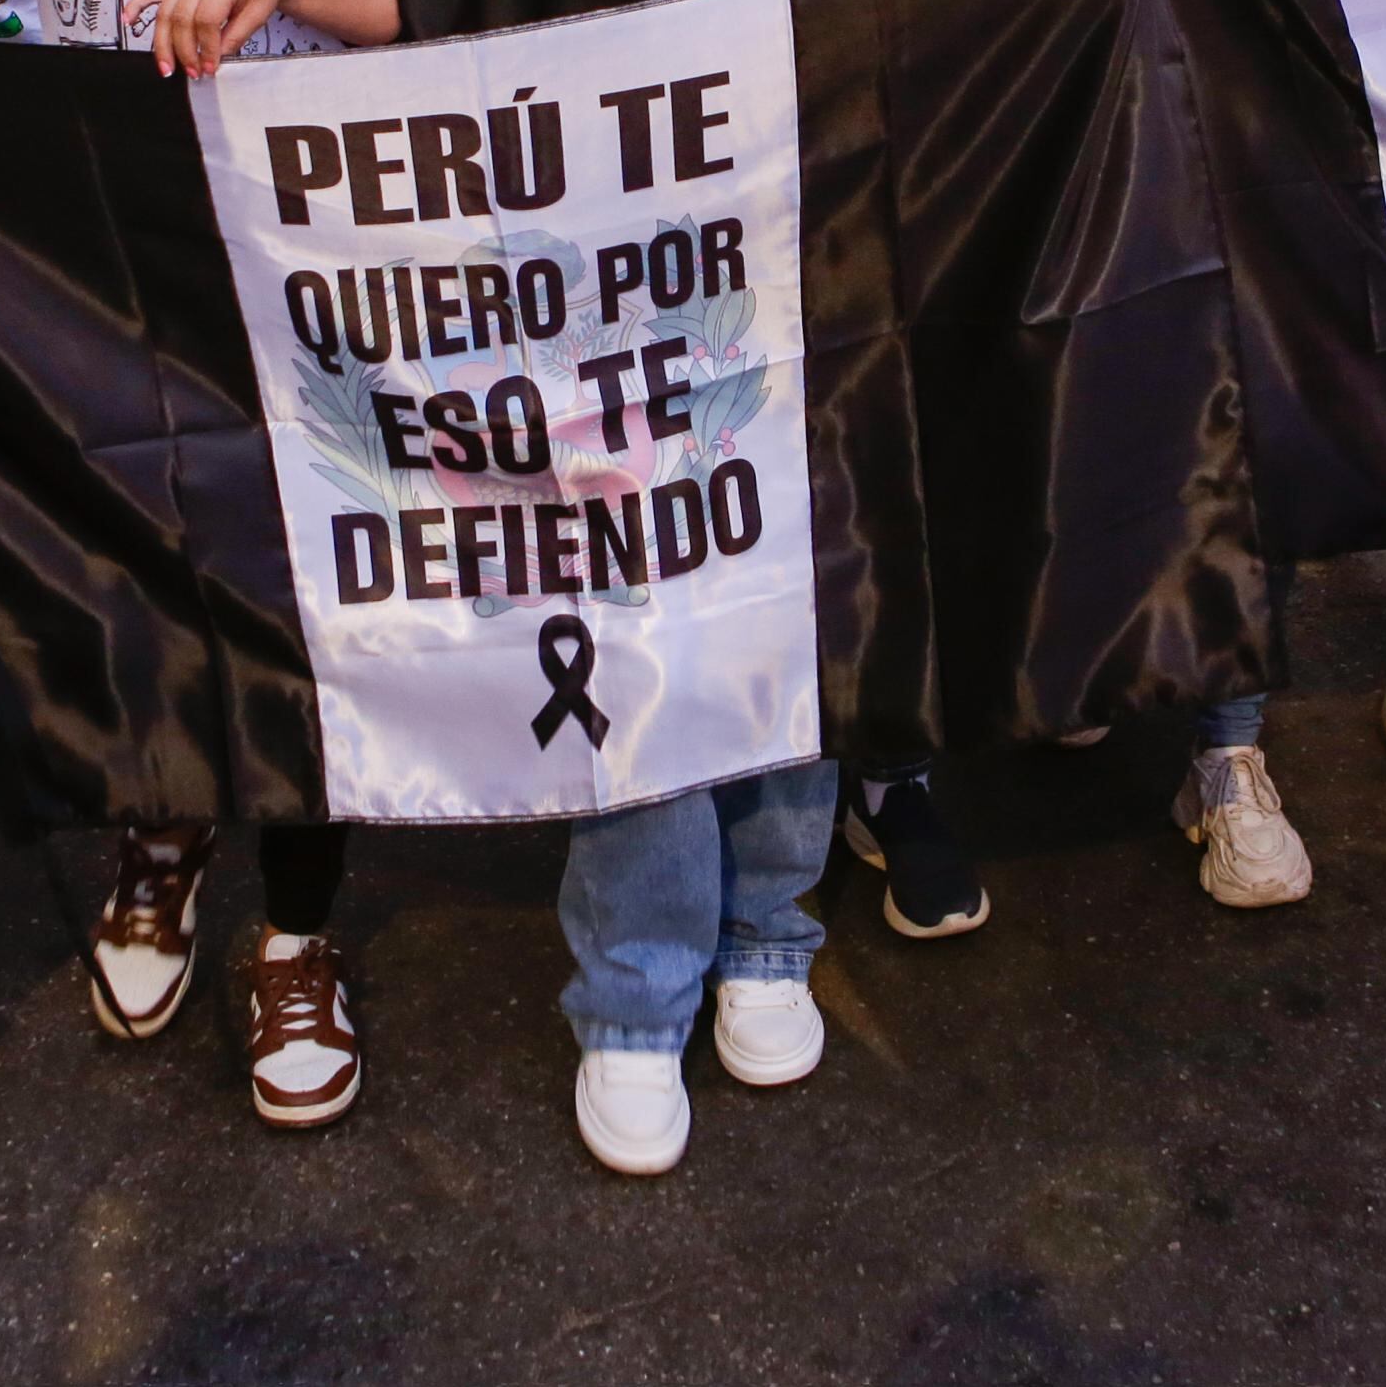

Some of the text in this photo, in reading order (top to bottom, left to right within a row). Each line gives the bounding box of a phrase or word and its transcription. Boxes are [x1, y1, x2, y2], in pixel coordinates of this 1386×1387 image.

[264, 71, 733, 226] PERÚ TE
[284, 216, 747, 375] QUIERO POR
[370, 337, 692, 474] ESO TE
[331, 458, 763, 604] DEFIENDO
